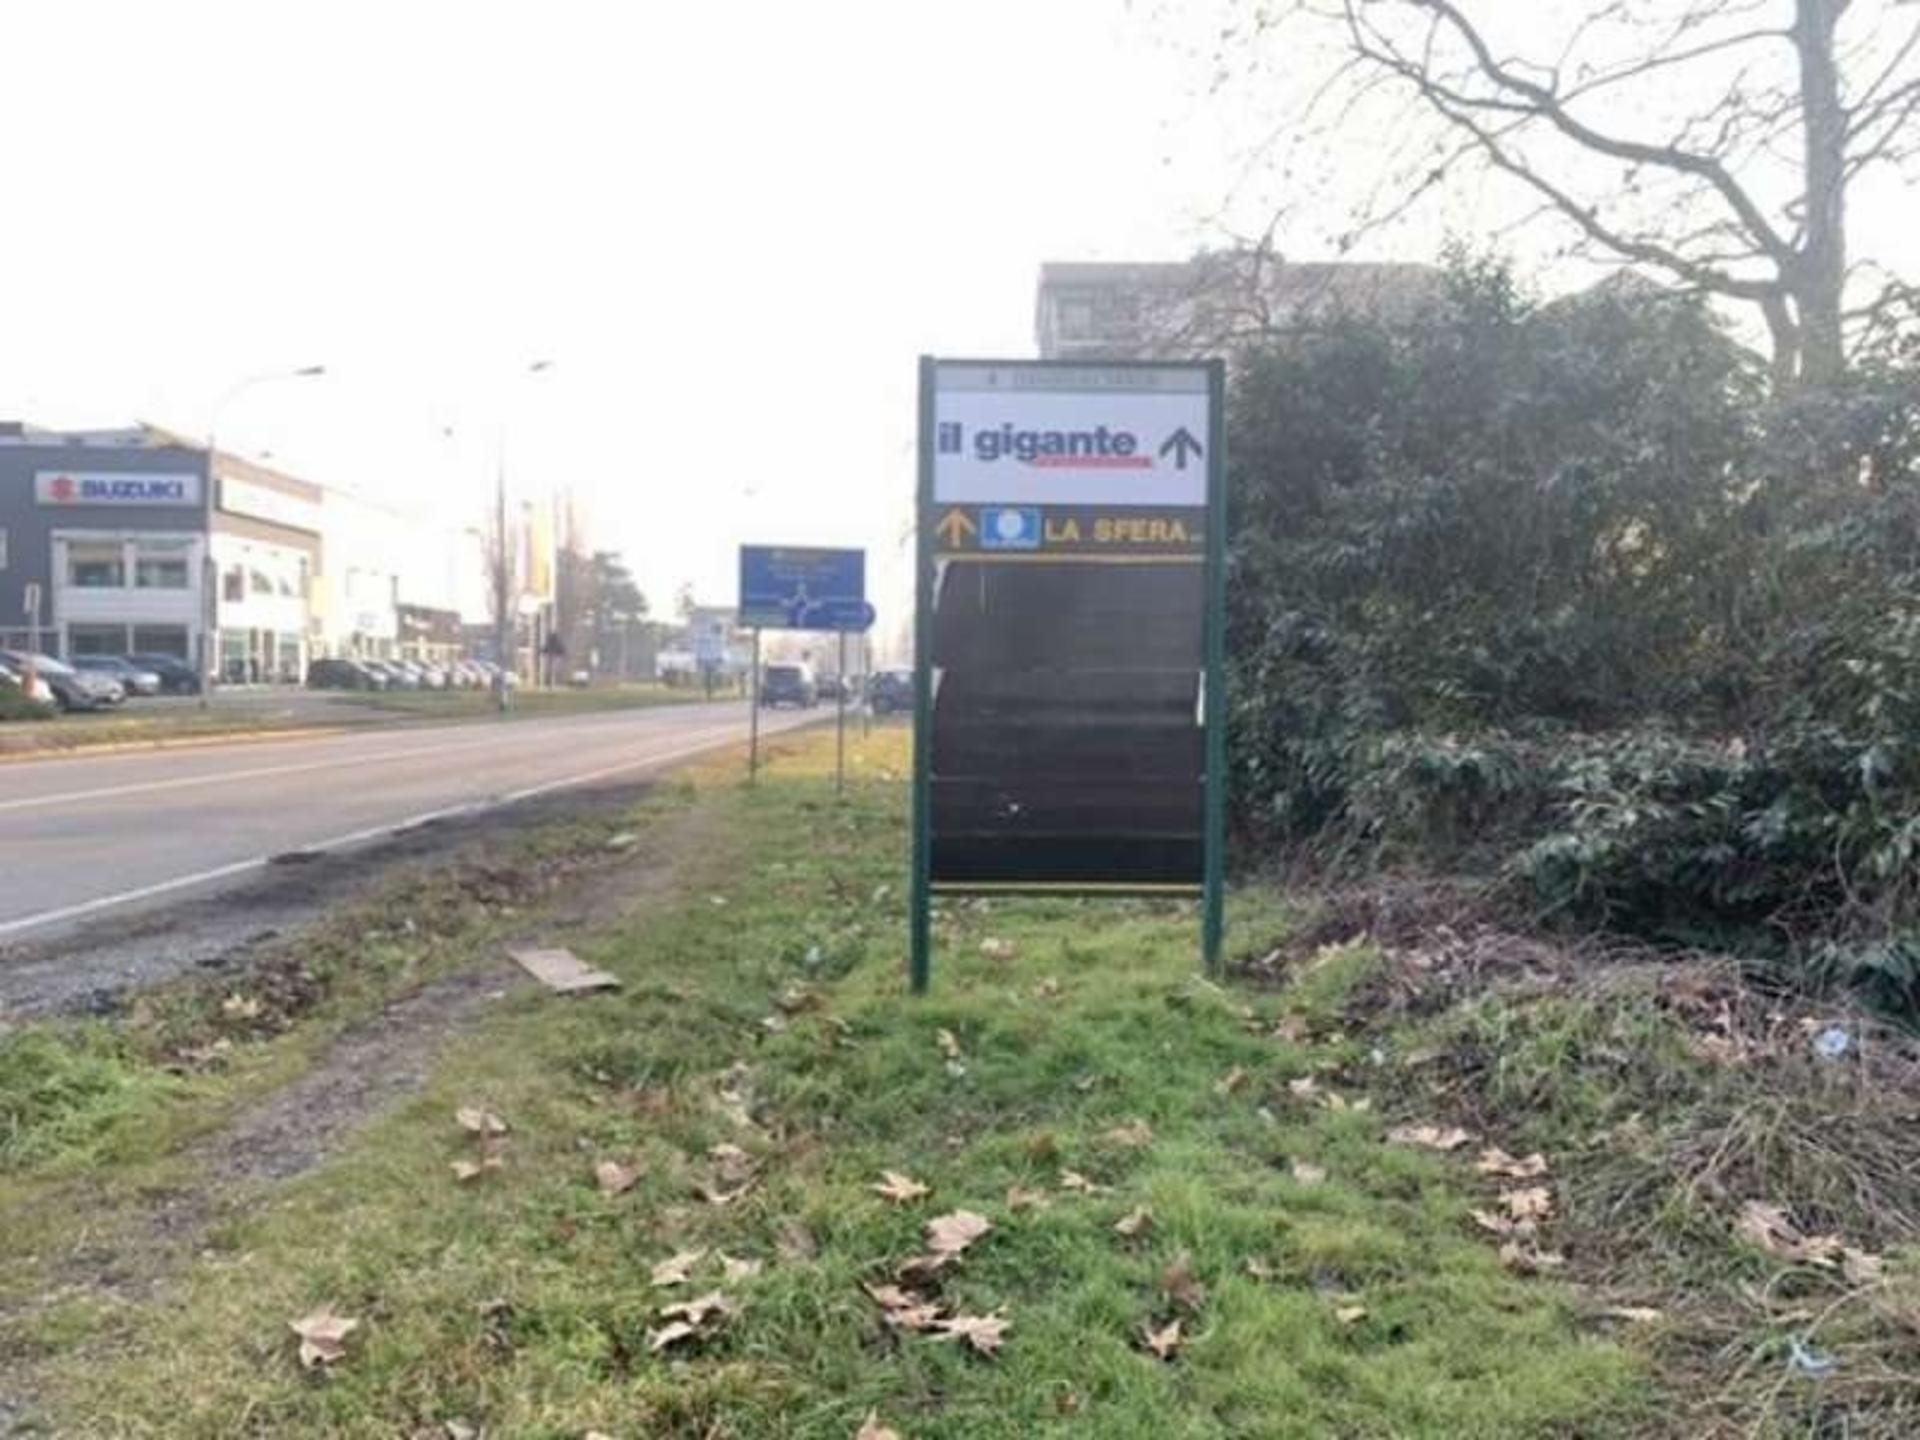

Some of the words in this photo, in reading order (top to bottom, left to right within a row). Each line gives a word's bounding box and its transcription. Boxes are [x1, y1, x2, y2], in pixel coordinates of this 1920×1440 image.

[938, 422, 962, 454] il
[973, 422, 1138, 462] gigante
[81, 479, 184, 500] SUZUKI
[1044, 518, 1080, 542] LA
[1093, 518, 1189, 542] SFERA
